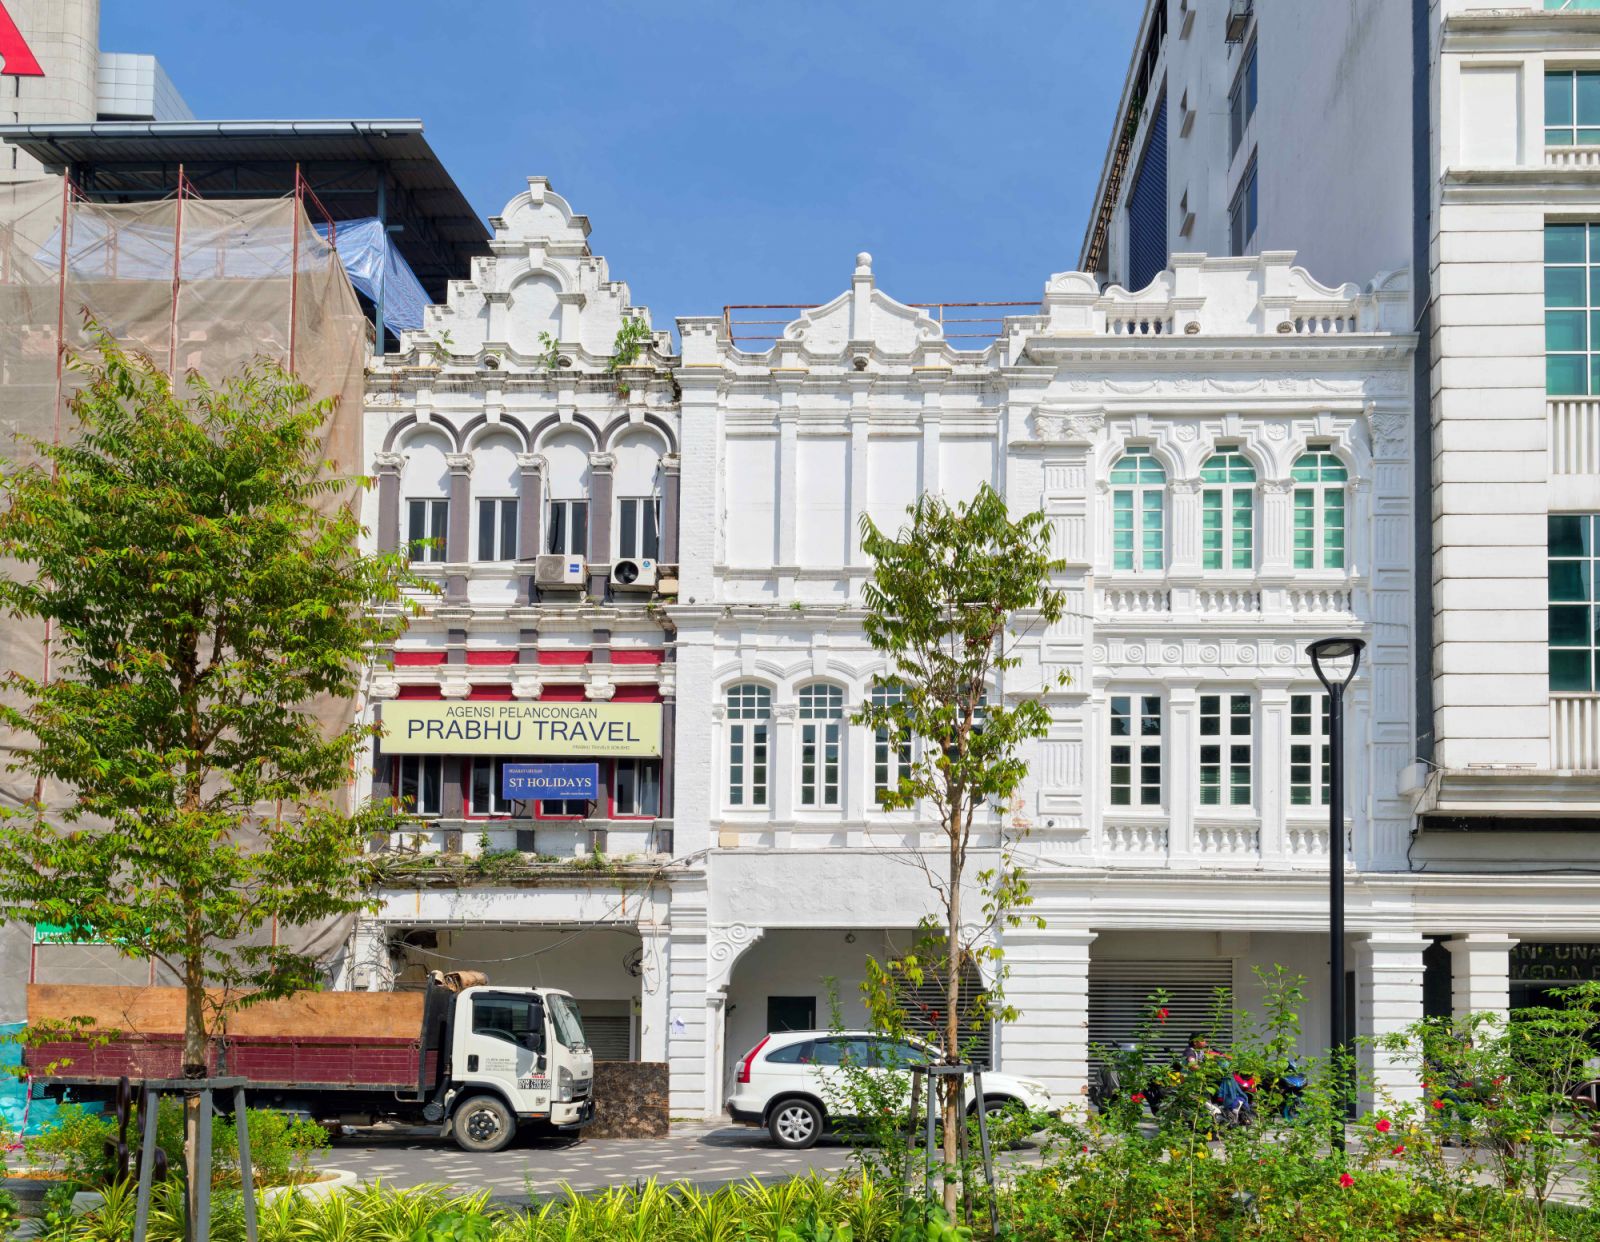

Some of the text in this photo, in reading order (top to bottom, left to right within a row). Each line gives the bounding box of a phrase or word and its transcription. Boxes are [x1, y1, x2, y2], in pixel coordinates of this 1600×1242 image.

[446, 706, 598, 719] AGENSI PELANCONGAN
[408, 719, 640, 742] PRABHU TRAVEL
[509, 777, 592, 788] ST HOLIDAYS
